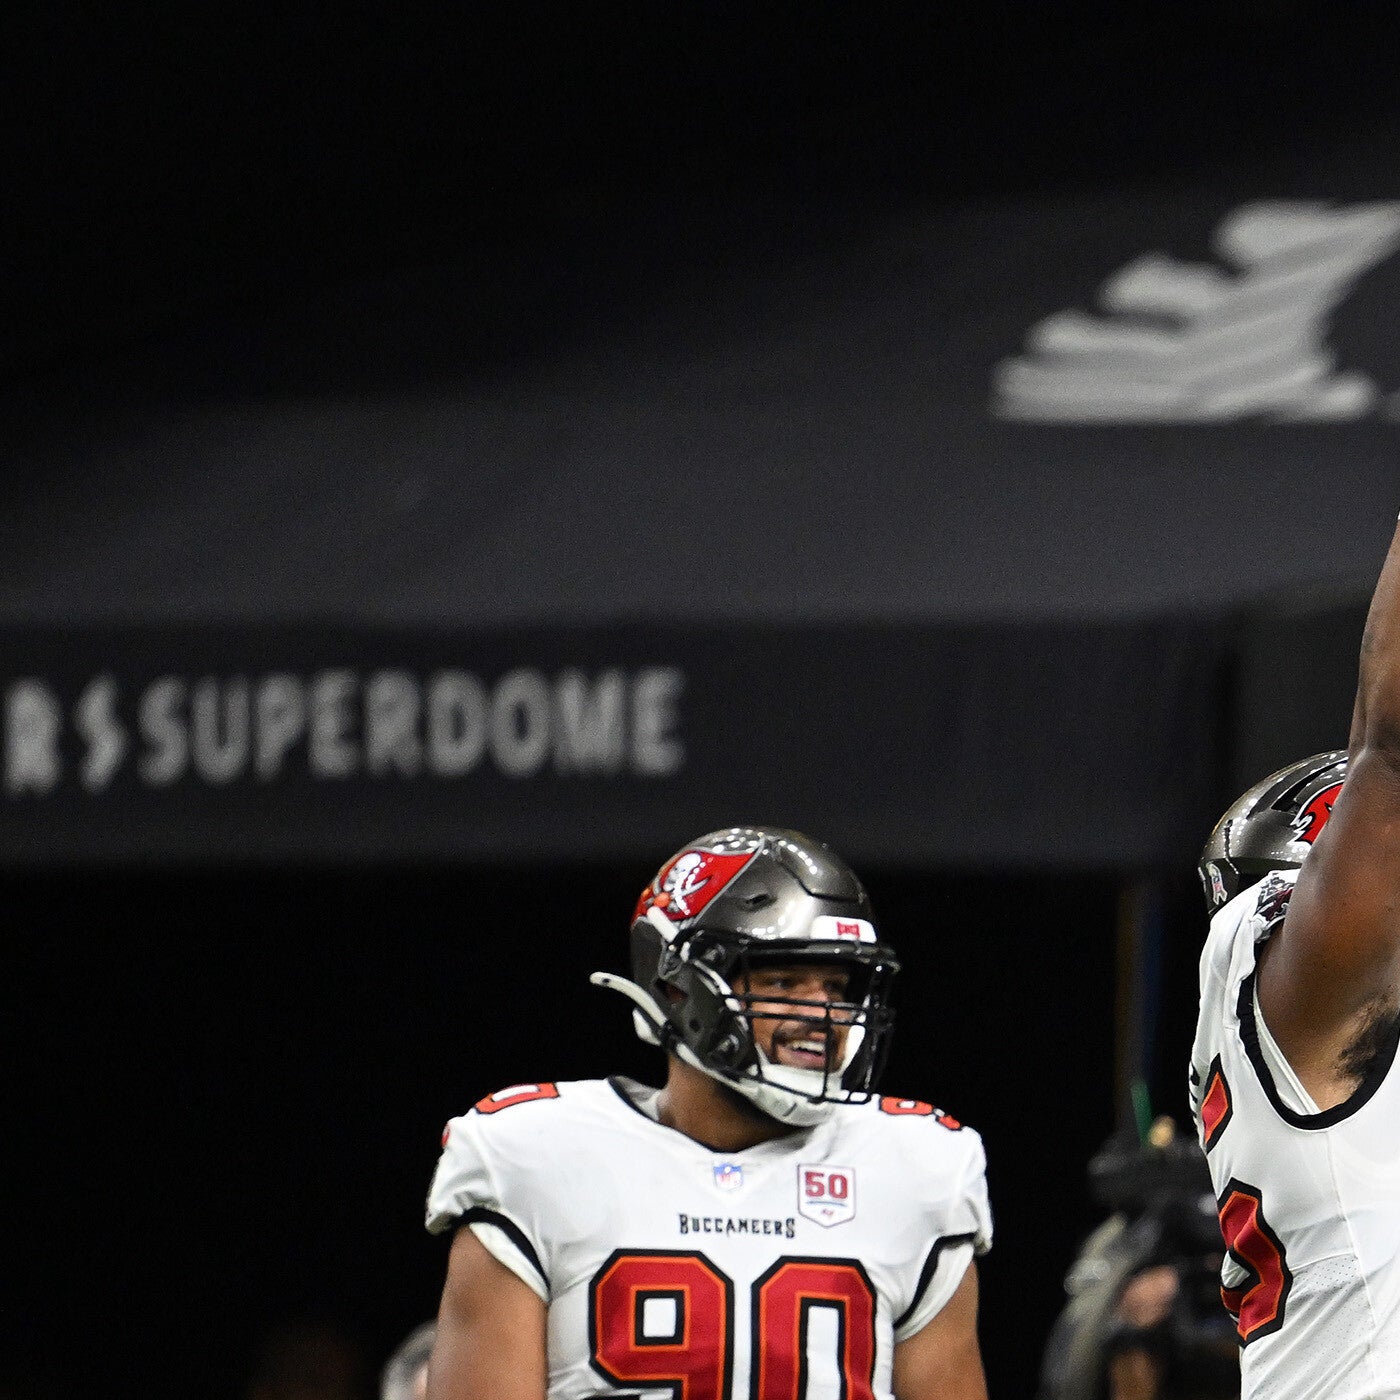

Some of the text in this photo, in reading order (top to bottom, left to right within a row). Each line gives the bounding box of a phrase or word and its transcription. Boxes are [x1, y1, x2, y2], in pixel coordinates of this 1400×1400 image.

[137, 667, 686, 786] SUPERDOME
[804, 1171, 849, 1200] 50
[678, 1212, 796, 1240] BUCCANEERS
